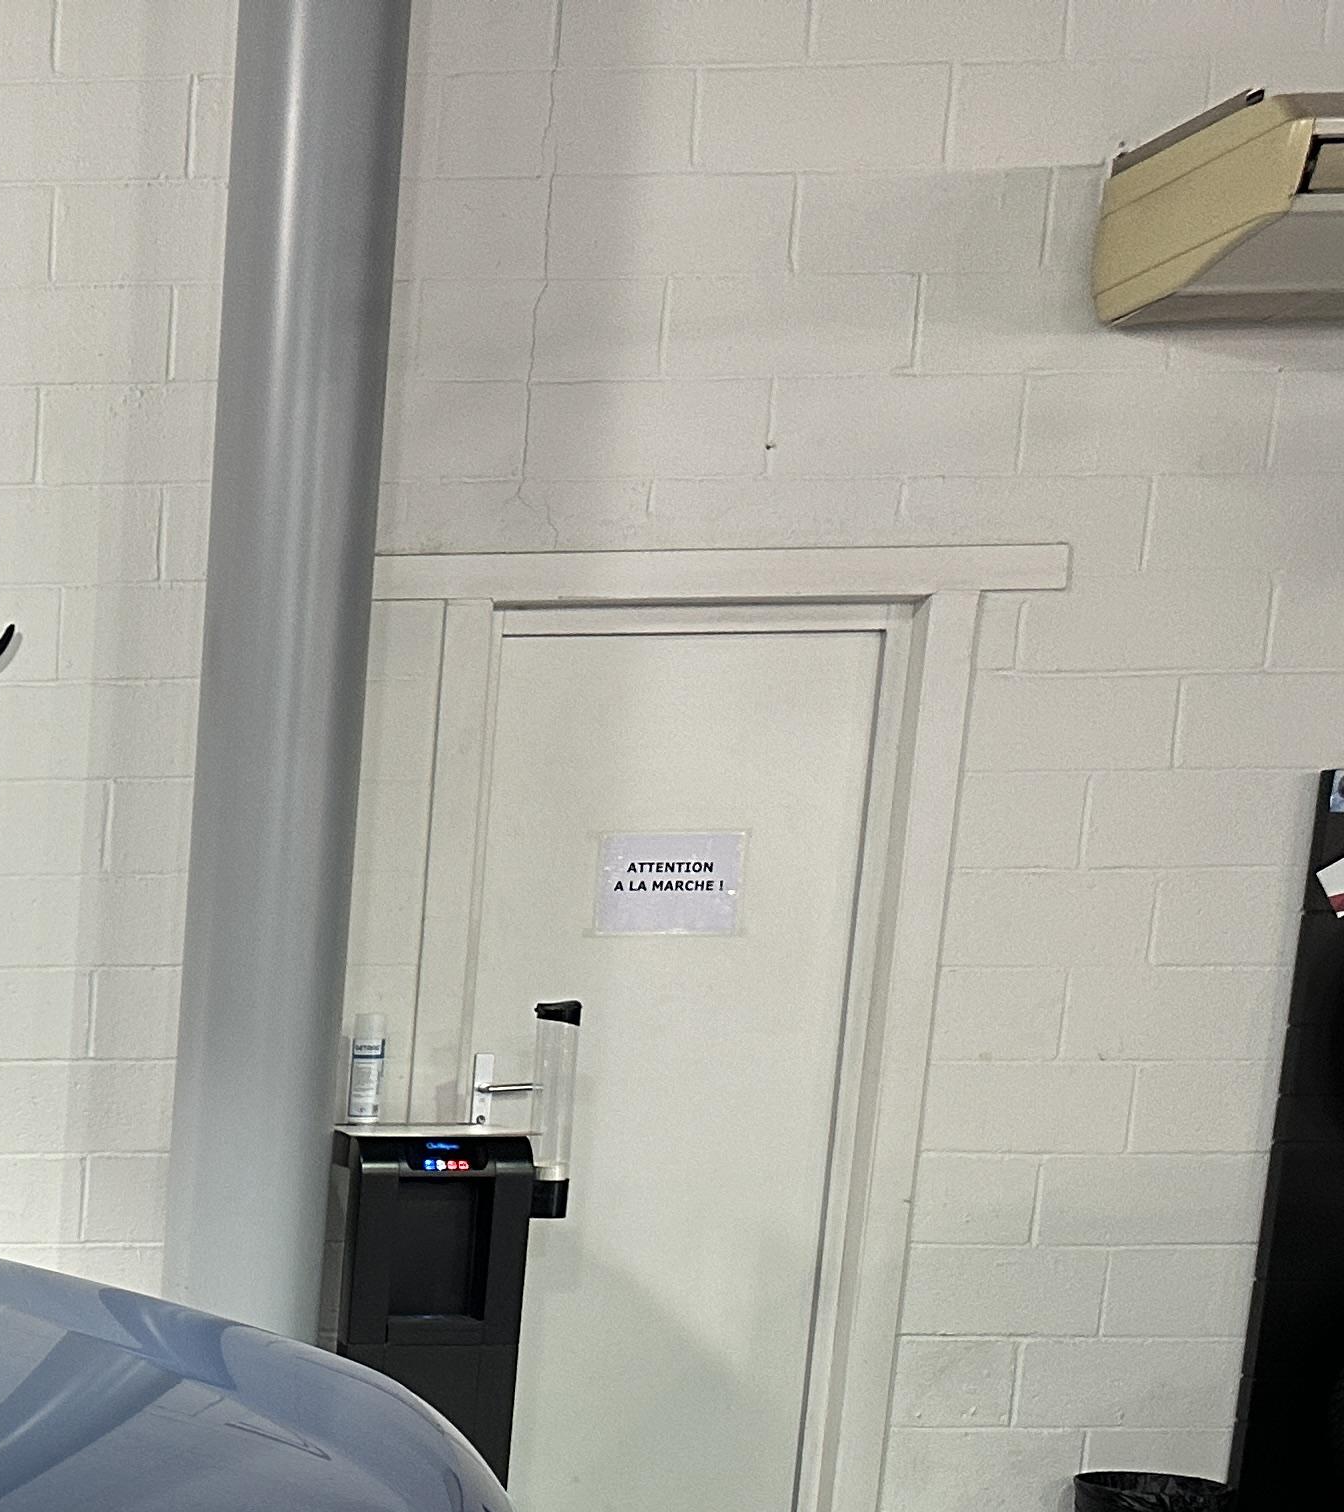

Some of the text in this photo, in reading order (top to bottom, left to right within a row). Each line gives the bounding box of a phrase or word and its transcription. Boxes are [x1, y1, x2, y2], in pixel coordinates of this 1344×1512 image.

[626, 861, 714, 874] ATTENTION
[613, 880, 724, 892] A LA MARCHE !
